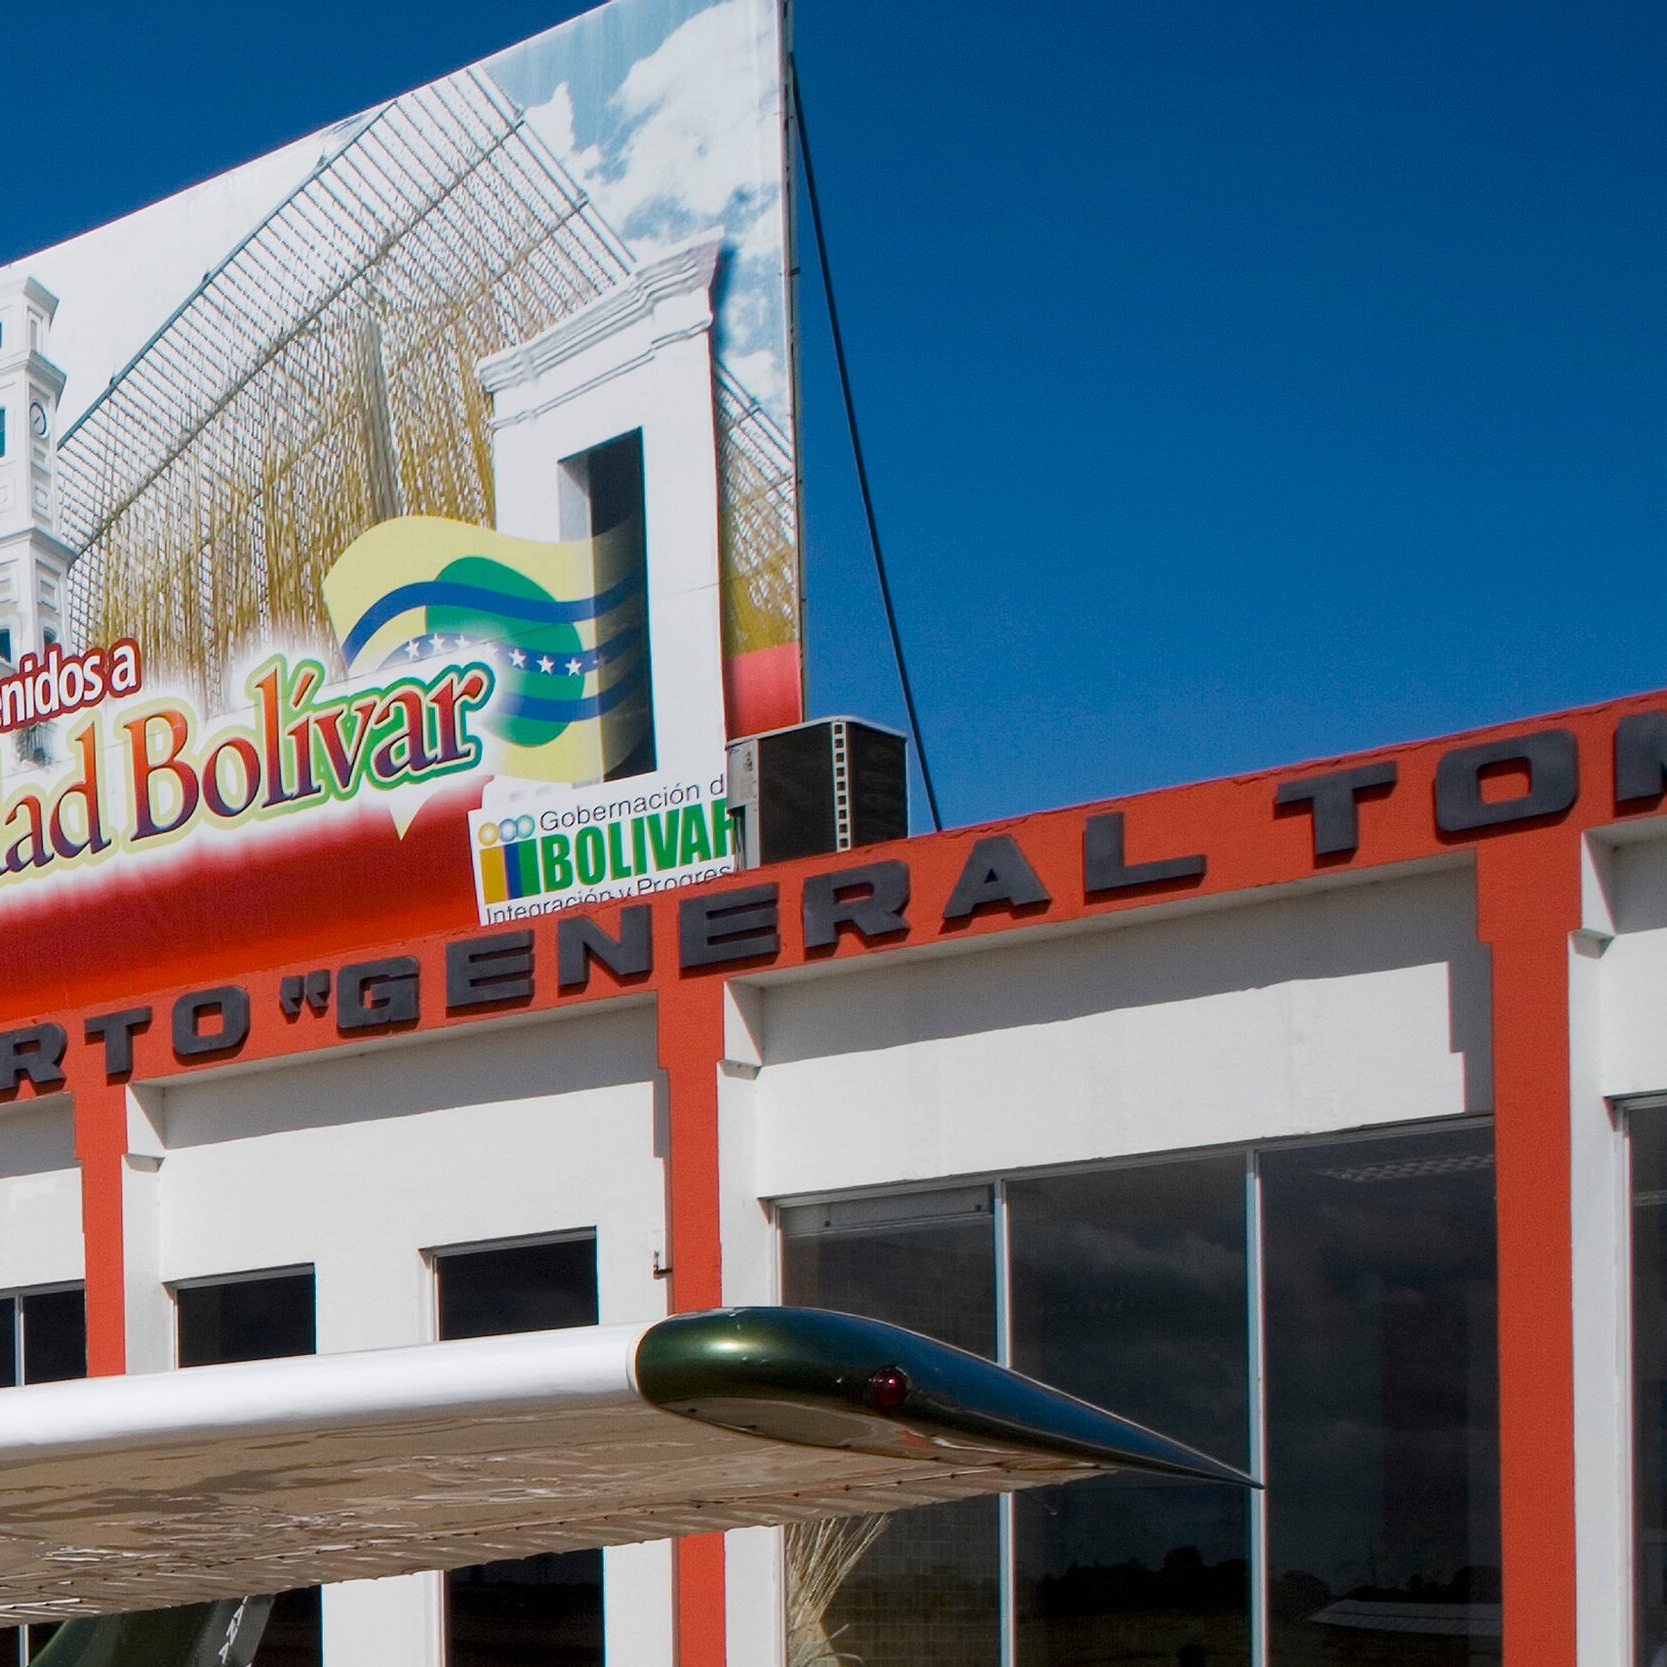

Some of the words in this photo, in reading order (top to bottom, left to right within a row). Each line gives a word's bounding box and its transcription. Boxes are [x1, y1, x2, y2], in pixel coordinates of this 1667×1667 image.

[110, 660, 137, 692] a
[122, 669, 485, 842] Bolívar
[540, 781, 701, 833] Gobernación
[709, 774, 727, 797] d
[636, 864, 733, 895] Progres
